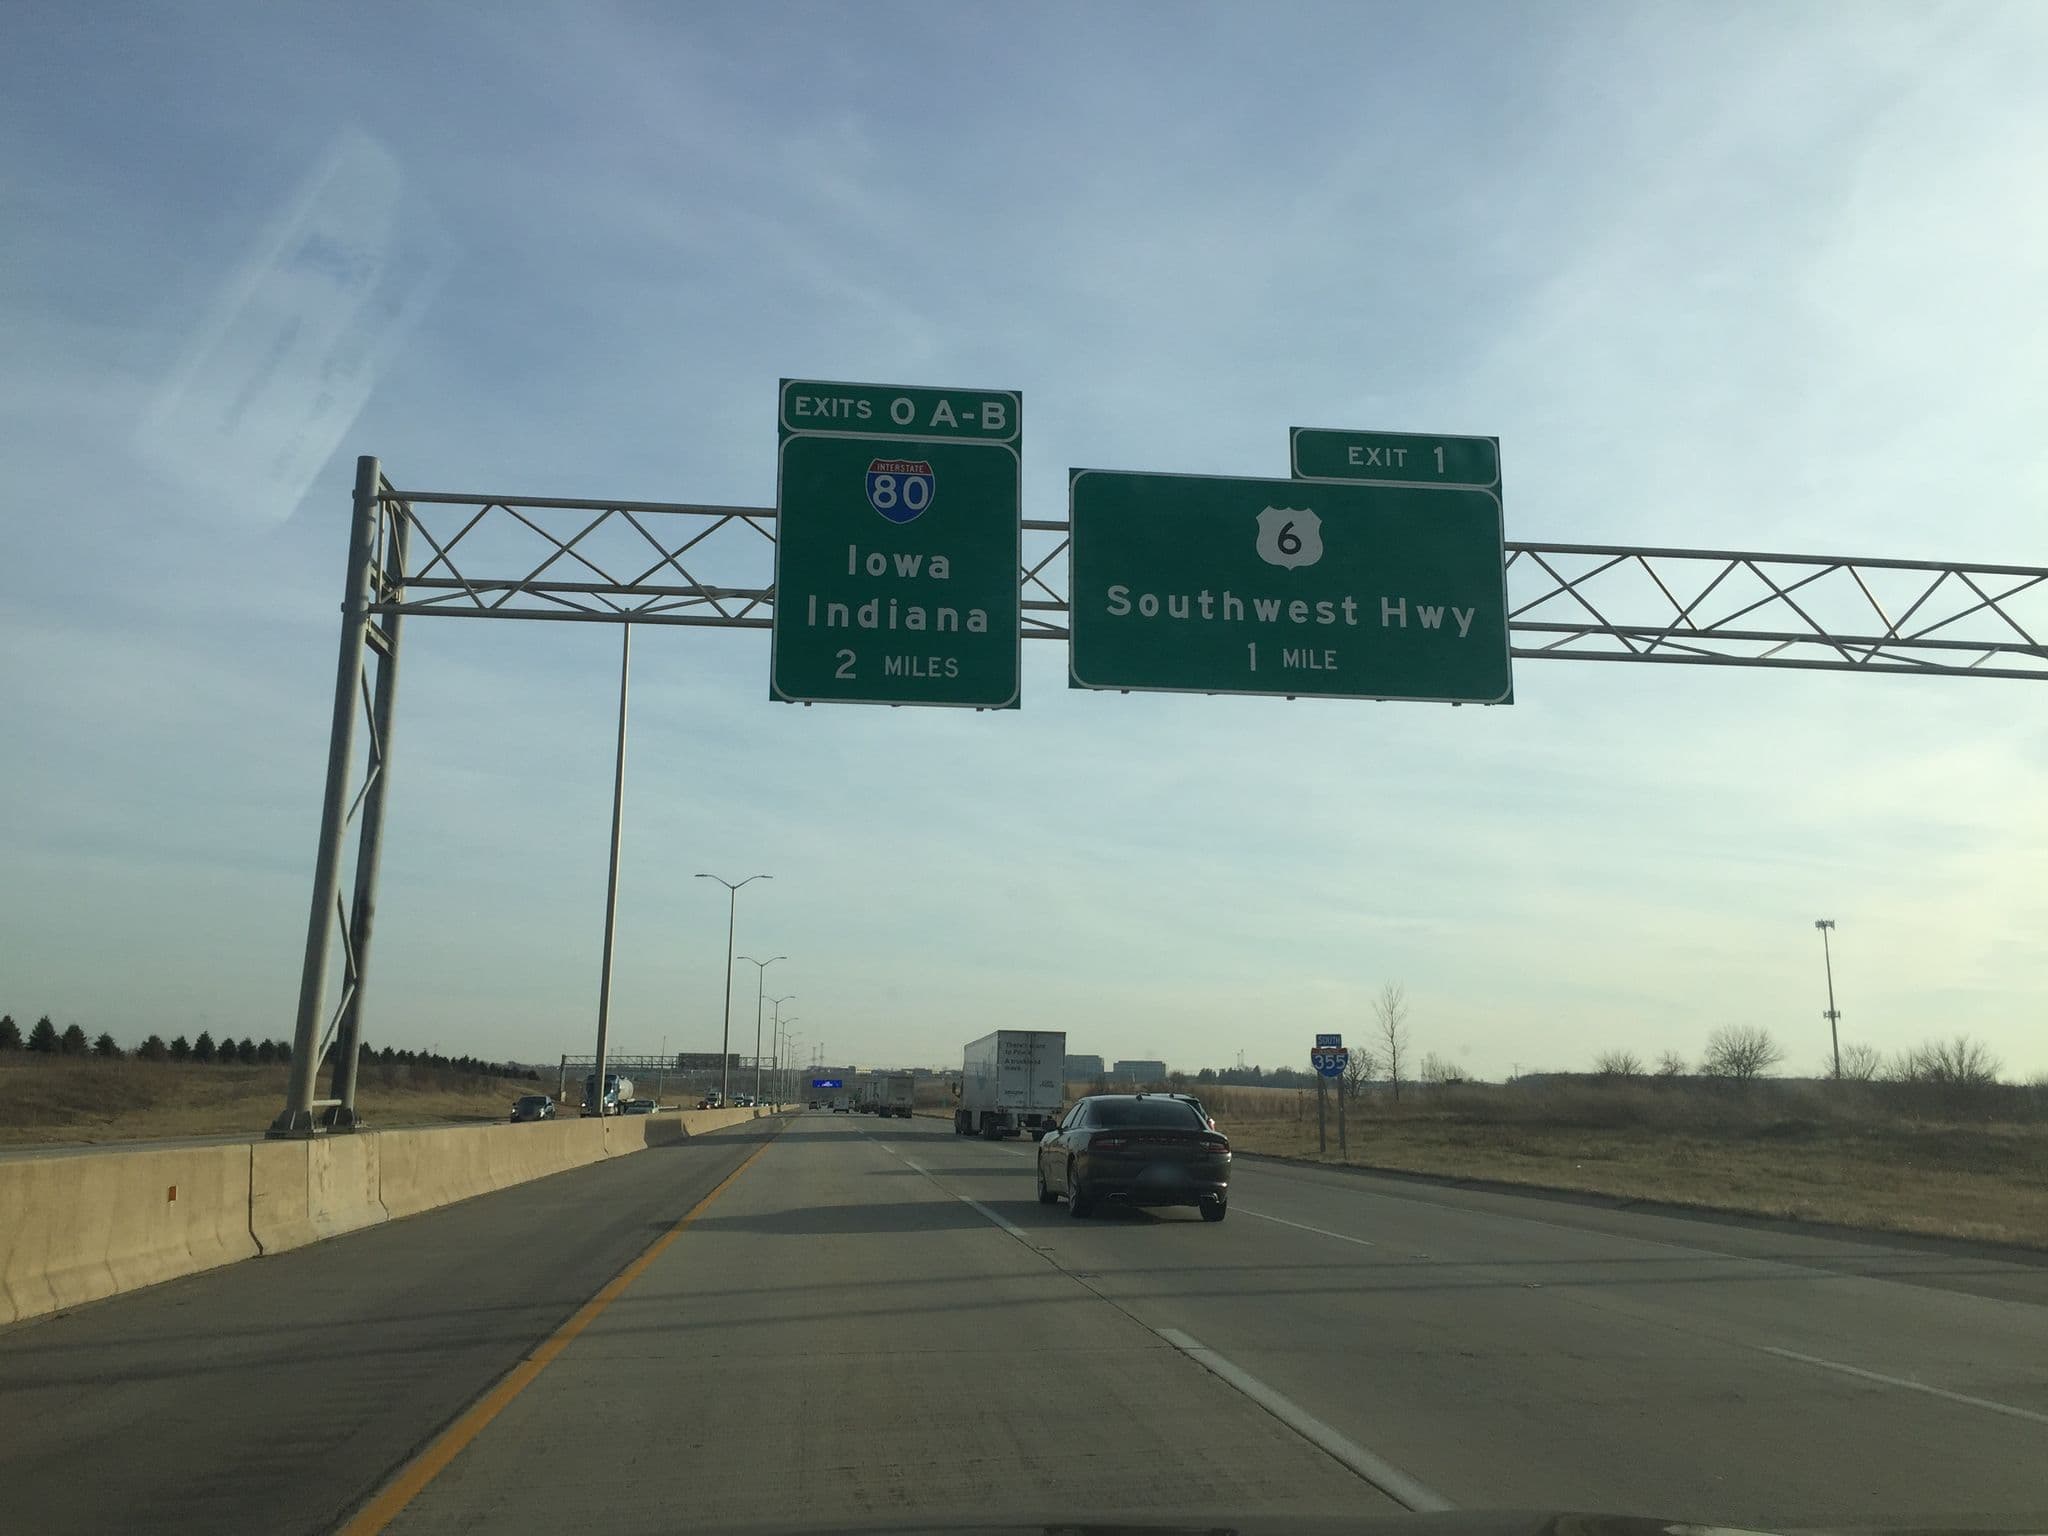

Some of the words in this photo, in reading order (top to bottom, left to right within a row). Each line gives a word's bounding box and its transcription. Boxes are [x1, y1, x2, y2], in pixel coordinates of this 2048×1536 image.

[795, 396, 873, 420] EXITS
[929, 399, 1006, 430] A-B
[876, 462, 925, 474] INTERSTATE
[1348, 446, 1408, 468] EXIT
[1433, 446, 1445, 474] 1
[872, 474, 929, 510] 80
[1277, 520, 1302, 556] 6
[848, 544, 950, 579] Iowa
[808, 594, 988, 633] Indiana
[1106, 585, 1358, 626] Southwest
[1381, 596, 1476, 639] Hwy
[834, 648, 857, 680] 2
[884, 655, 960, 678] MILES
[1247, 642, 1257, 671] 1
[1283, 648, 1338, 671] MILE
[1314, 1055, 1346, 1070] 355
